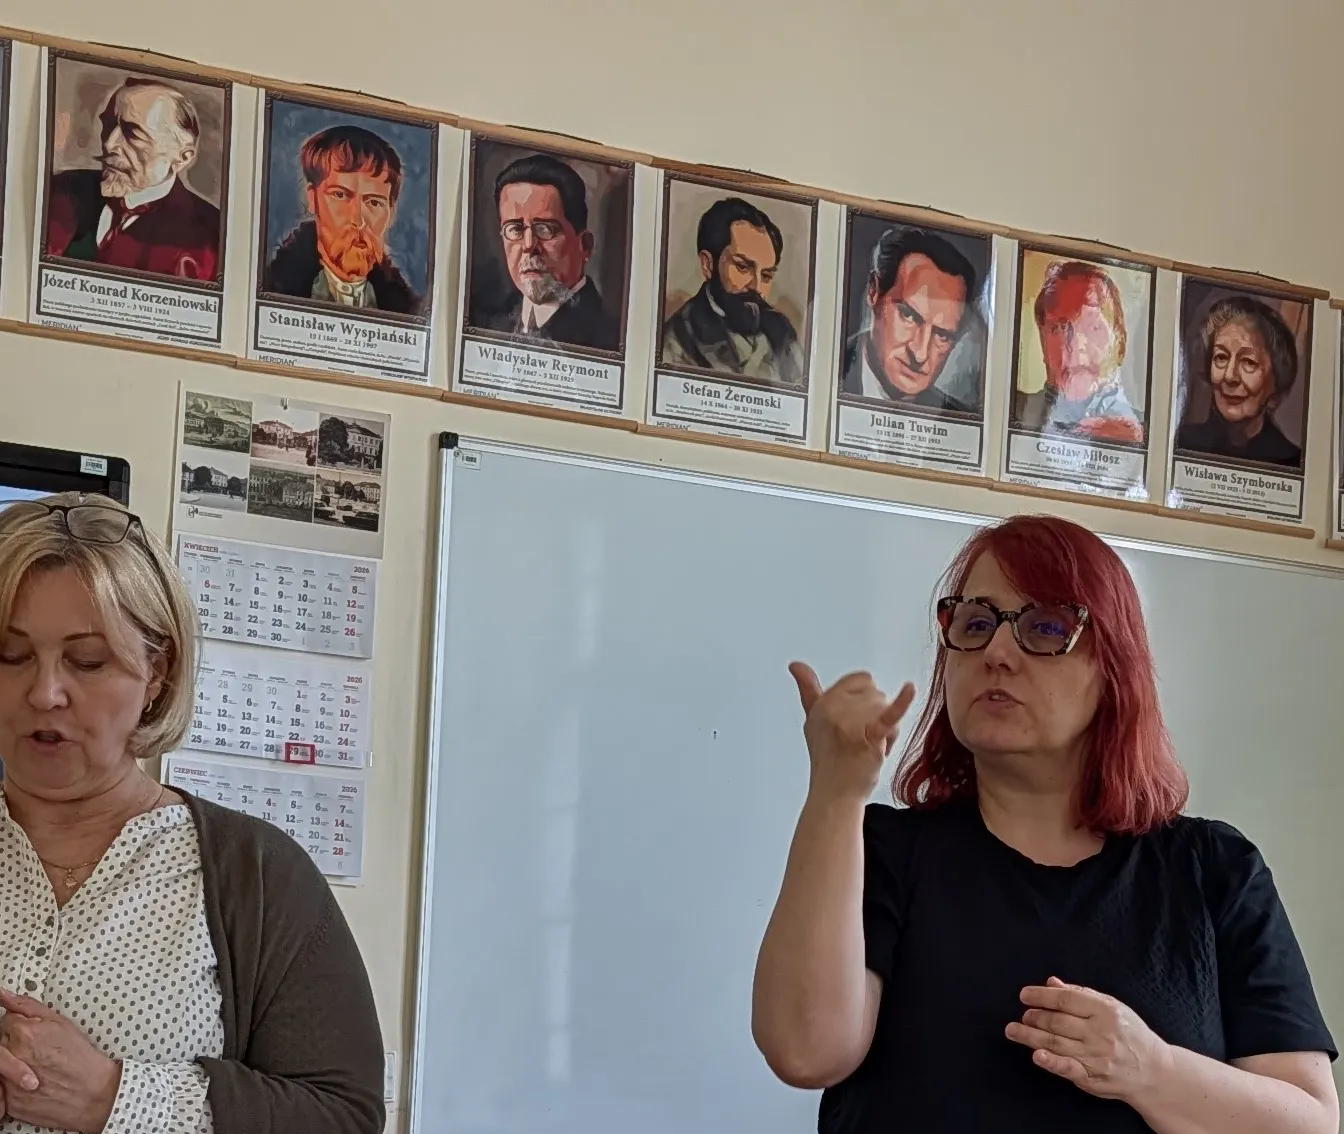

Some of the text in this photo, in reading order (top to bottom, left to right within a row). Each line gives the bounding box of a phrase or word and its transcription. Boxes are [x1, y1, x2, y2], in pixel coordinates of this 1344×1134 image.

[43, 273, 217, 313] Józef Konrad Korzeniowski
[269, 311, 417, 346] Stanisław Wyspiański
[478, 346, 608, 379] Władysław Reymont
[683, 382, 781, 409] Stefan Żeromski
[870, 414, 948, 436] Julian Tuwim
[1036, 442, 1120, 464] Czesław Miłosz
[1185, 466, 1293, 493] Wisława Szymborska
[204, 580, 356, 608] 6 7 8 9 10 11 12
[256, 573, 357, 594] 1 2 3 4 5
[199, 594, 356, 622] 13 14 15 16 17 18 19
[198, 608, 355, 636] 20 21 22 23 24 25 26
[222, 626, 282, 641] 28 29 30
[217, 709, 349, 732] 12 13 14 15 16 17
[334, 819, 345, 827] 14
[308, 831, 345, 842] 20 21
[333, 847, 344, 855] 28
